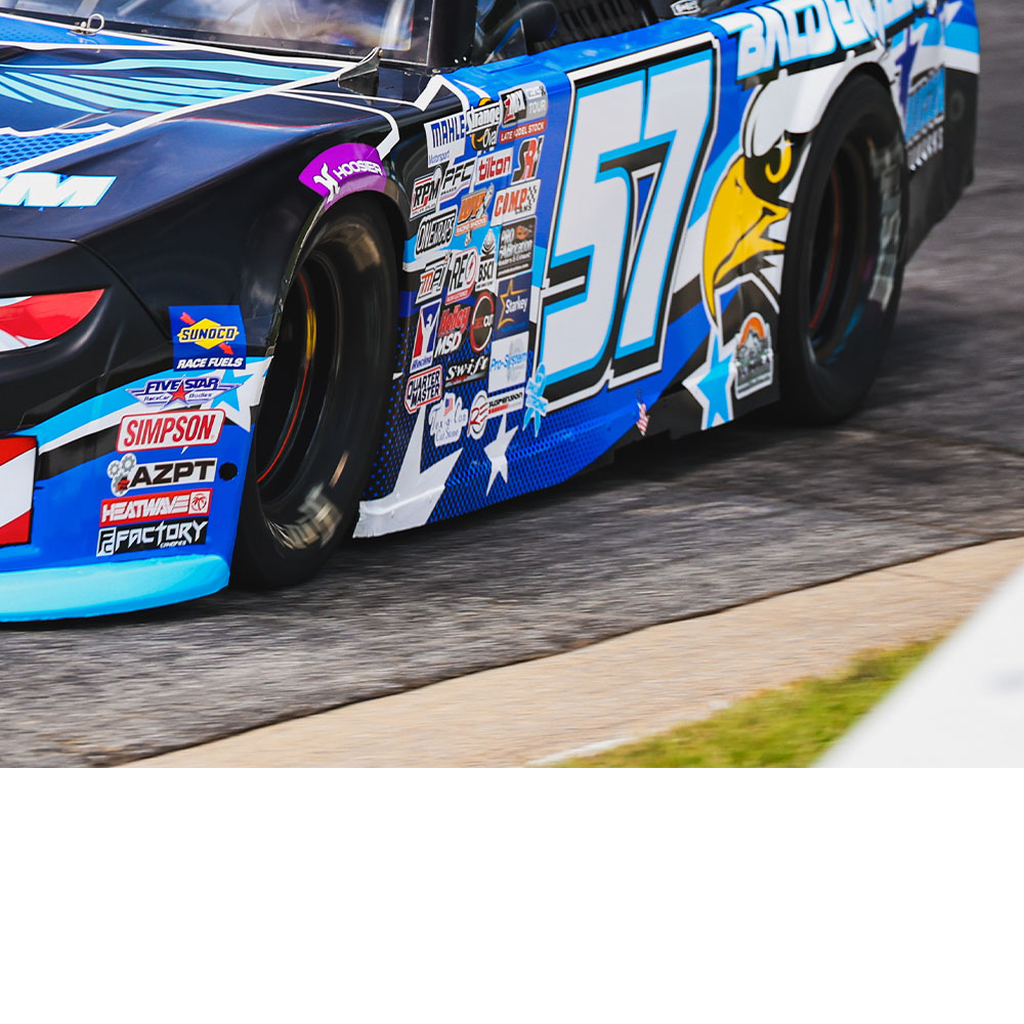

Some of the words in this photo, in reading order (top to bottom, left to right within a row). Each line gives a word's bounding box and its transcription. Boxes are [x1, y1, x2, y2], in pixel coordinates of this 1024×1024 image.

[333, 160, 383, 179] HOOSIER
[442, 160, 475, 190] PFC
[479, 156, 511, 181] tilton
[413, 178, 440, 208] RPM
[494, 188, 527, 217] COMP
[537, 42, 715, 396] 57
[505, 296, 528, 314] Starkey
[181, 328, 236, 342] SUNOCO
[434, 331, 462, 358] MSD
[177, 359, 206, 369] RACE
[208, 357, 243, 368] FUELS
[145, 380, 179, 394] FIVE
[185, 378, 219, 390] STAR
[407, 370, 440, 399] QUARTER
[411, 384, 440, 407] MASTER
[124, 414, 216, 447] SIMPSON
[129, 460, 216, 488] AZPT
[101, 495, 190, 523] HEATWAVE
[115, 520, 208, 552] FACTORY
